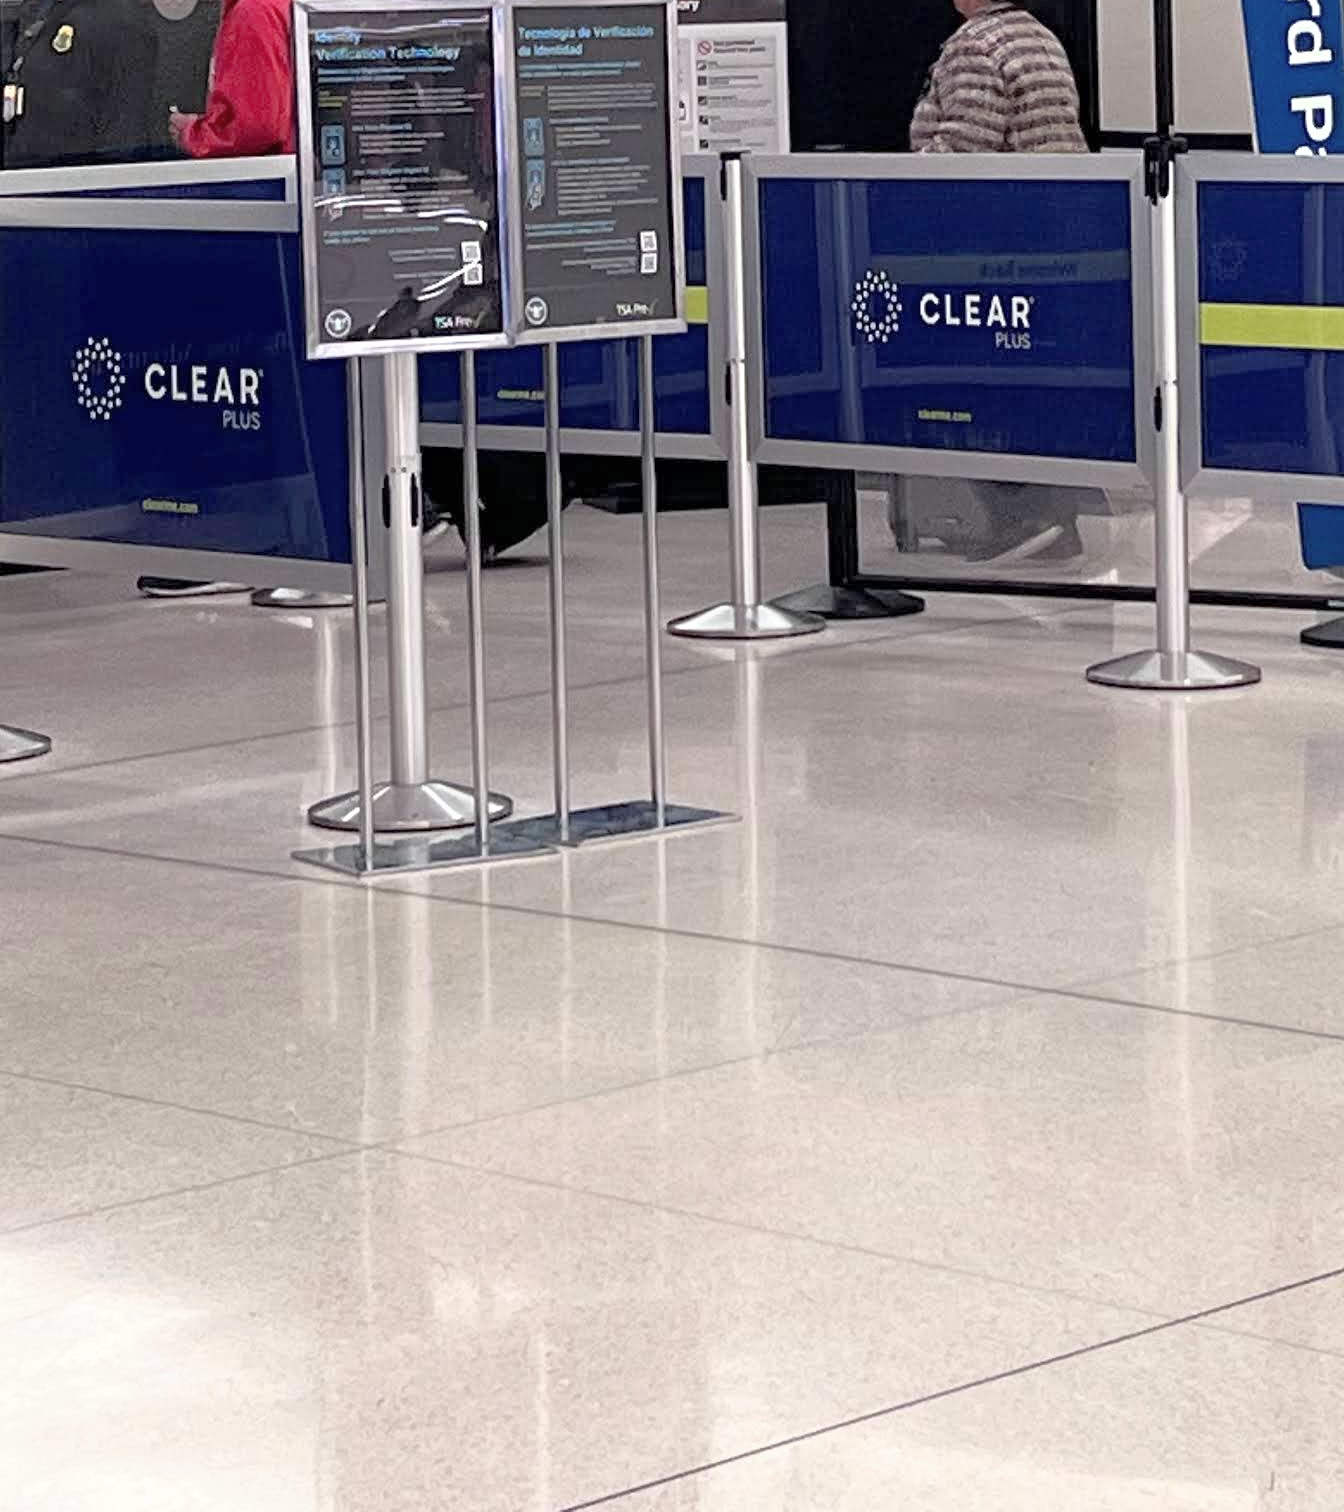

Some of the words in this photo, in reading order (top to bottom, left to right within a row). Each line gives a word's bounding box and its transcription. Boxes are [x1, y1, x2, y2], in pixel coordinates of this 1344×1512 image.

[919, 292, 1031, 328] CLEAR
[994, 331, 1032, 350] PLUS
[144, 363, 260, 405] CLEAR
[222, 409, 261, 431] PLUS
